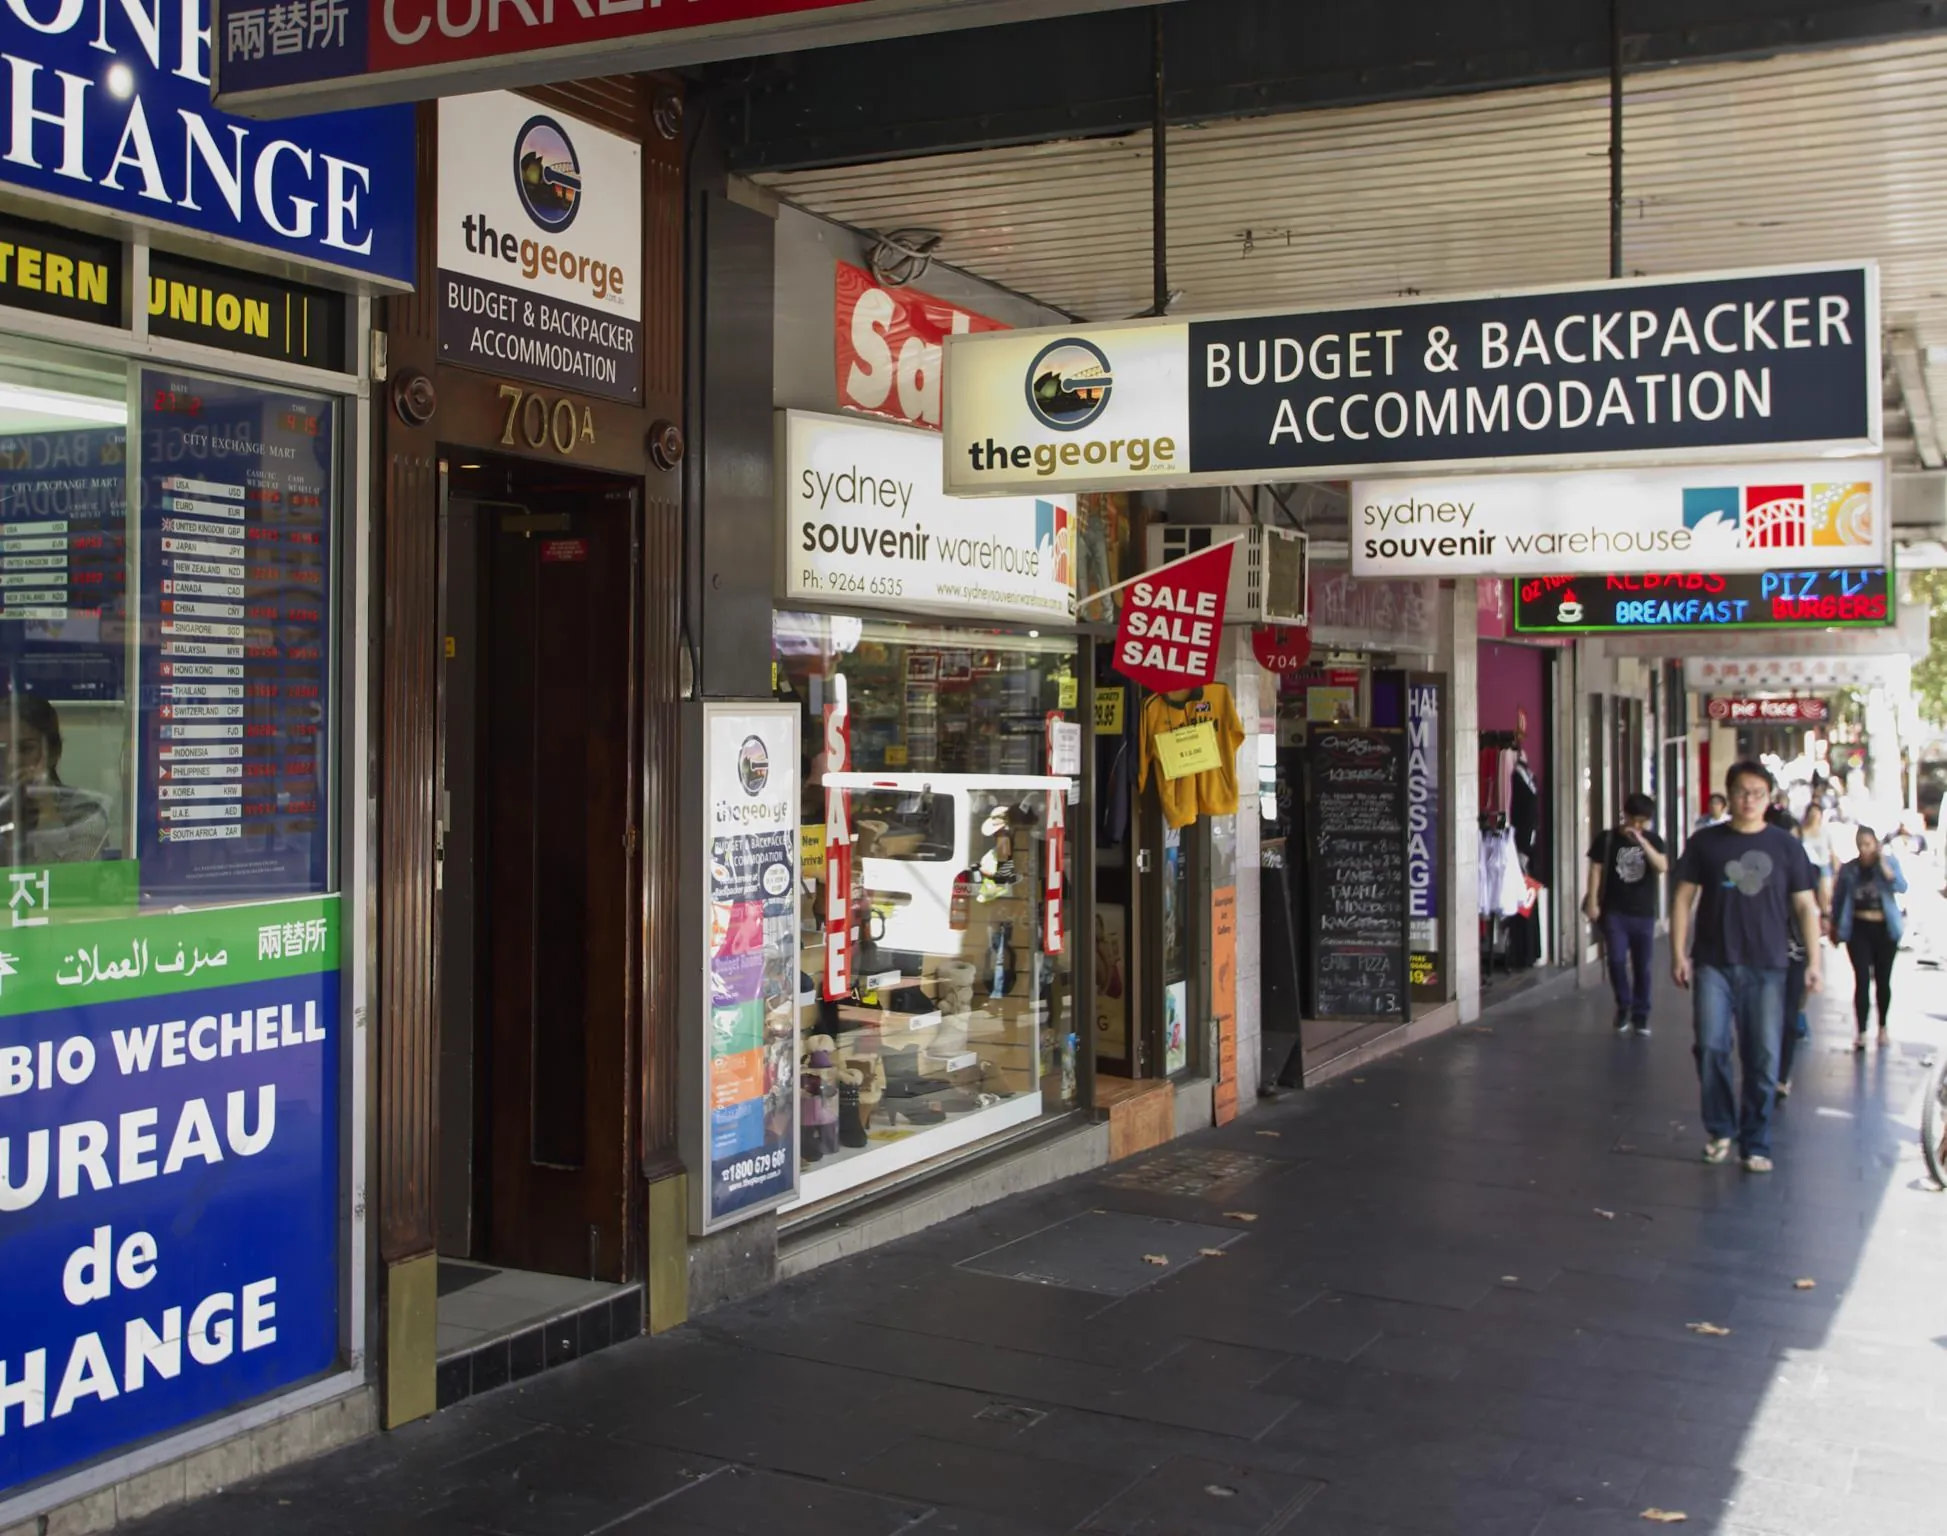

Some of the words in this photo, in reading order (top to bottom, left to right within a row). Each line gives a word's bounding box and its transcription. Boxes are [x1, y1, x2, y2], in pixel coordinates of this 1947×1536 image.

[2, 53, 373, 255] HANGE
[462, 213, 624, 299] thegeorge
[148, 276, 270, 338] UNION
[448, 281, 518, 327] BUDGET
[523, 301, 535, 326] &
[540, 306, 634, 353] BACKPACKER
[470, 327, 617, 384] ACCOMMODATION
[1206, 329, 1403, 389] BUDGET
[1423, 325, 1459, 374] &
[1481, 295, 1853, 370] BACKPACKER
[846, 288, 970, 426] Sa
[499, 385, 596, 454] 700A
[1269, 367, 1773, 445] ACCOMMODATION
[183, 432, 208, 445] CITY
[212, 436, 266, 455] EXCHANGE
[269, 446, 296, 460] MART
[968, 435, 1176, 477] thegeorge
[91, 477, 118, 488] MART
[176, 480, 190, 490] USA
[228, 488, 241, 497] USD
[802, 465, 913, 518] sydney
[176, 500, 194, 511] EURO
[228, 508, 241, 517] EUR
[1363, 497, 1475, 530] sydney
[176, 521, 197, 531] UNITED
[198, 522, 225, 534] KINGDOM
[228, 526, 241, 536] GBP
[176, 541, 197, 552] JAPAN
[229, 546, 240, 556] JPY
[802, 521, 929, 562] souvenir
[936, 534, 1039, 578] warehouse
[1364, 529, 1496, 559] souvenir
[1504, 526, 1692, 555] warehouse
[176, 563, 190, 573] NEW
[191, 563, 221, 574] ZEALAND
[228, 567, 241, 577] NZD
[802, 569, 823, 590] Ph:
[828, 572, 865, 593] 9264
[870, 575, 903, 597] 6535
[175, 583, 202, 593] CANADA
[1131, 582, 1217, 618] SALE
[175, 603, 195, 613] CHINA
[227, 606, 240, 616] CNY
[1616, 600, 1750, 624] BREAKFAST
[1771, 594, 1887, 621] BURGERS
[175, 624, 212, 635] SINGAPORE
[1127, 611, 1214, 648] SALE
[174, 645, 207, 655] MALAYSIA
[227, 646, 240, 656] MYR
[1121, 641, 1209, 677] SALE
[1266, 655, 1299, 669] 704
[174, 665, 193, 675] HONG
[194, 665, 213, 675] KONG
[227, 666, 240, 675] HKD
[174, 686, 207, 696] THAILAND
[227, 686, 240, 696] THB
[174, 706, 219, 717] SWITZERLAND
[226, 706, 240, 716] CHF
[174, 727, 185, 736] FIJI
[227, 726, 239, 736] FJD
[174, 747, 208, 758] INDONESIA
[228, 746, 239, 756] IDR
[173, 766, 211, 777] PHILIPPINES
[226, 765, 239, 775] PHP
[172, 787, 195, 798] KOREA
[224, 806, 238, 816] AED
[1408, 721, 1429, 917] MASSAGE
[172, 829, 195, 840] SOUTH
[195, 826, 218, 838] AFRICA
[225, 825, 238, 836] ZAR
[802, 835, 820, 847] New
[0, 1035, 96, 1097] BIO
[111, 1000, 327, 1076] WECHELL
[0, 1084, 276, 1212] UREAU
[730, 1159, 754, 1181] 1800
[62, 1224, 158, 1306] de
[0, 1276, 277, 1438] HANGE
